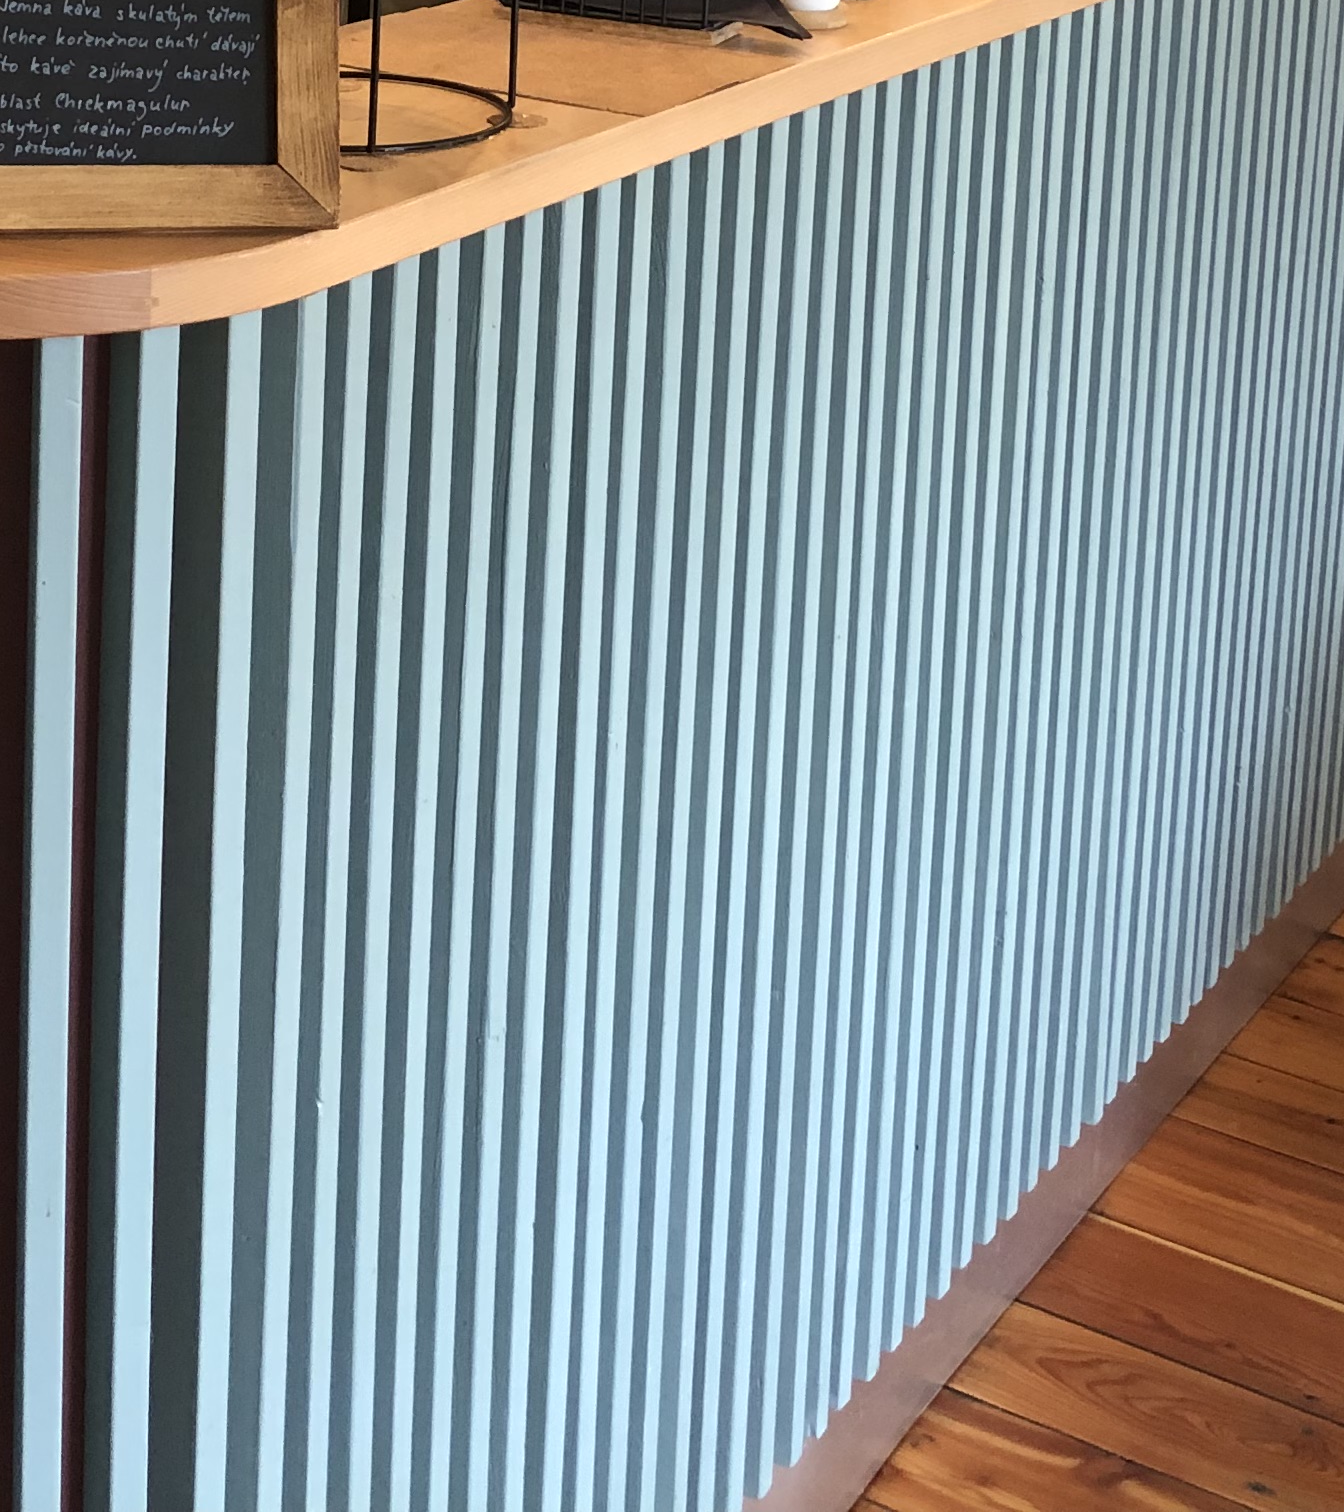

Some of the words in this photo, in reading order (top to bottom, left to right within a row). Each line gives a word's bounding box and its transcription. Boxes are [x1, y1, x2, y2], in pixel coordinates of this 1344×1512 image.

[206, 6, 251, 24] tělem
[3, 26, 46, 45] lehce
[56, 27, 148, 49] kořeněnou
[156, 32, 208, 50] chutí
[211, 34, 260, 58] dávají
[30, 57, 76, 74] kávě
[88, 59, 168, 92] zajímavý
[56, 92, 190, 121] Chickmagulur
[73, 118, 135, 137] ideální
[142, 117, 234, 138] podmínky
[15, 141, 93, 157] pěstování
